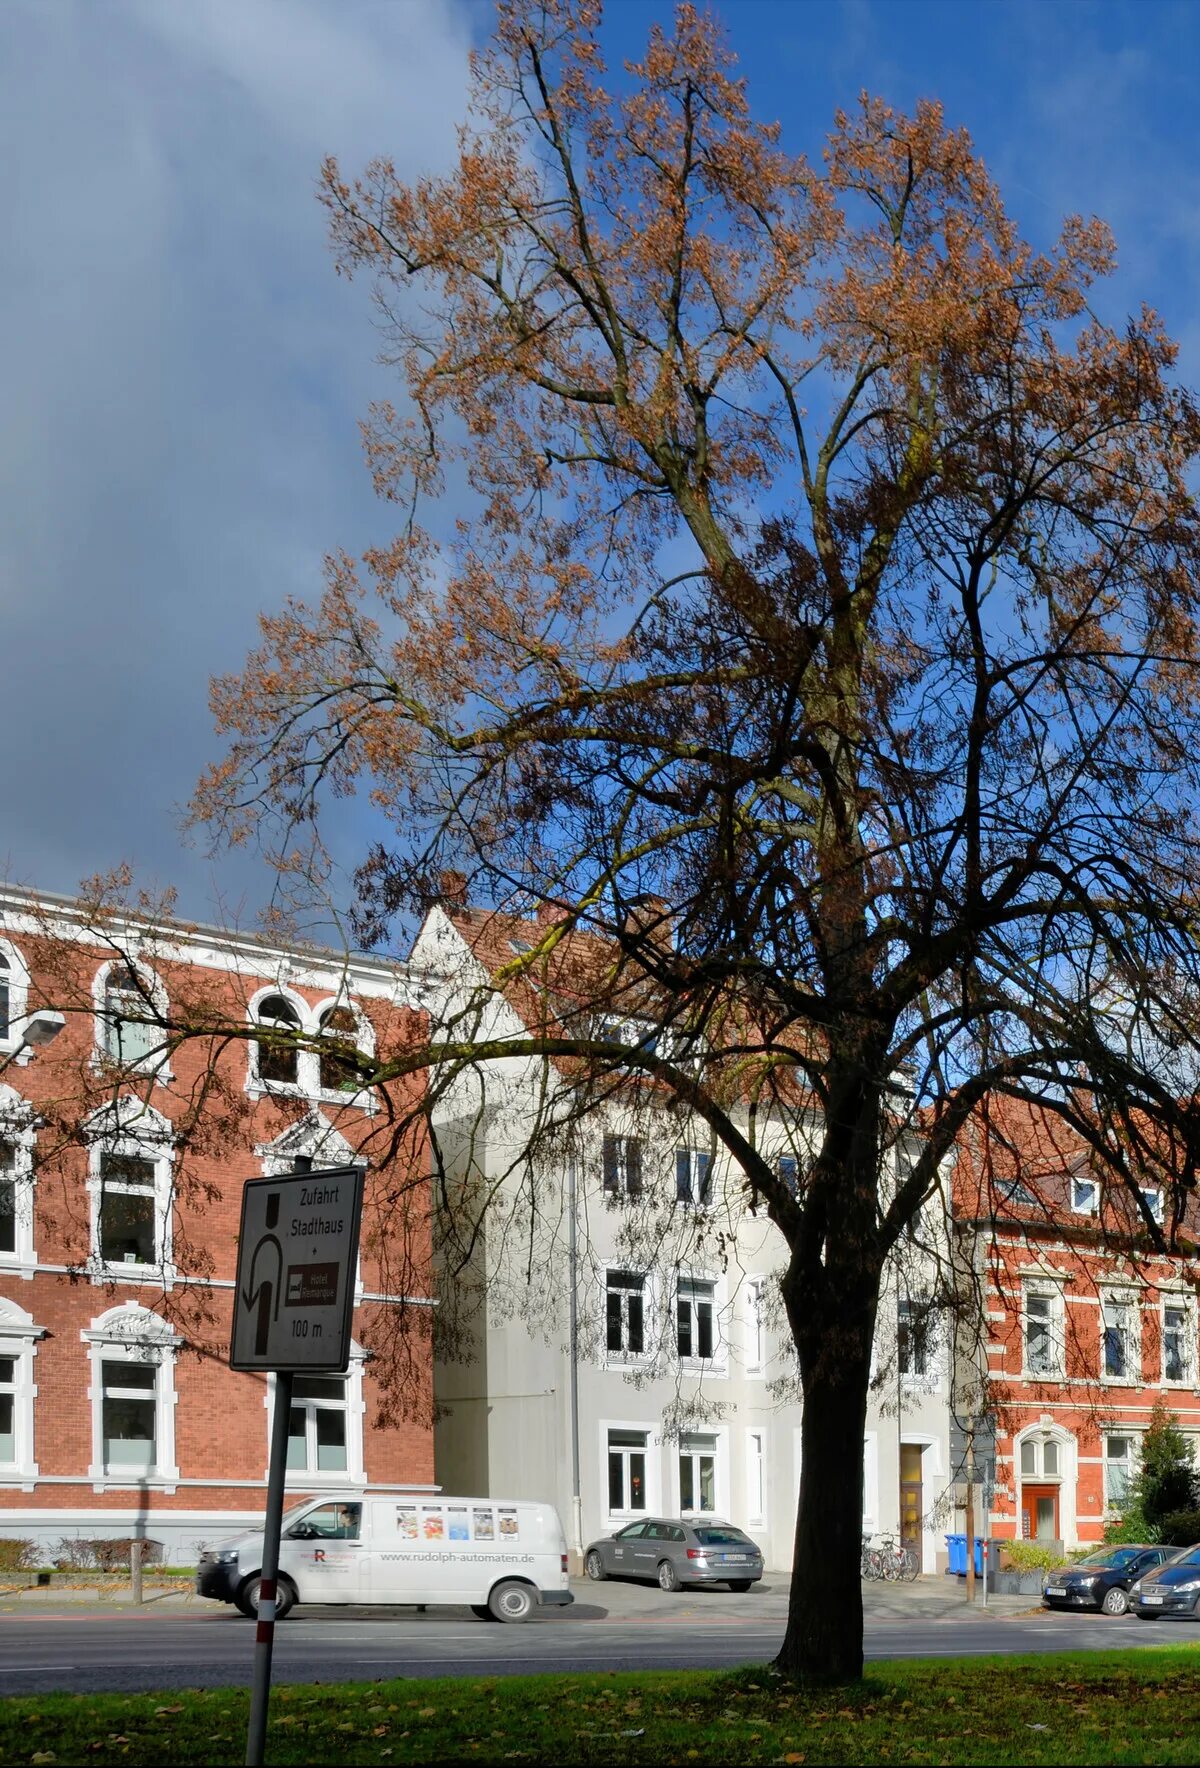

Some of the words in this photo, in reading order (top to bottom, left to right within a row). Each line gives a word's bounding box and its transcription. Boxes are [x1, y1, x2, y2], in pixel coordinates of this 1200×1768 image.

[300, 1186, 339, 1206] Zufahrt
[290, 1217, 343, 1237] Stadthaus
[310, 1273, 328, 1285] Hotel
[292, 1319, 308, 1338] 100
[311, 1324, 322, 1337] m
[314, 1549, 326, 1562] R
[381, 1552, 535, 1563] www.rudolph-automaten.de
